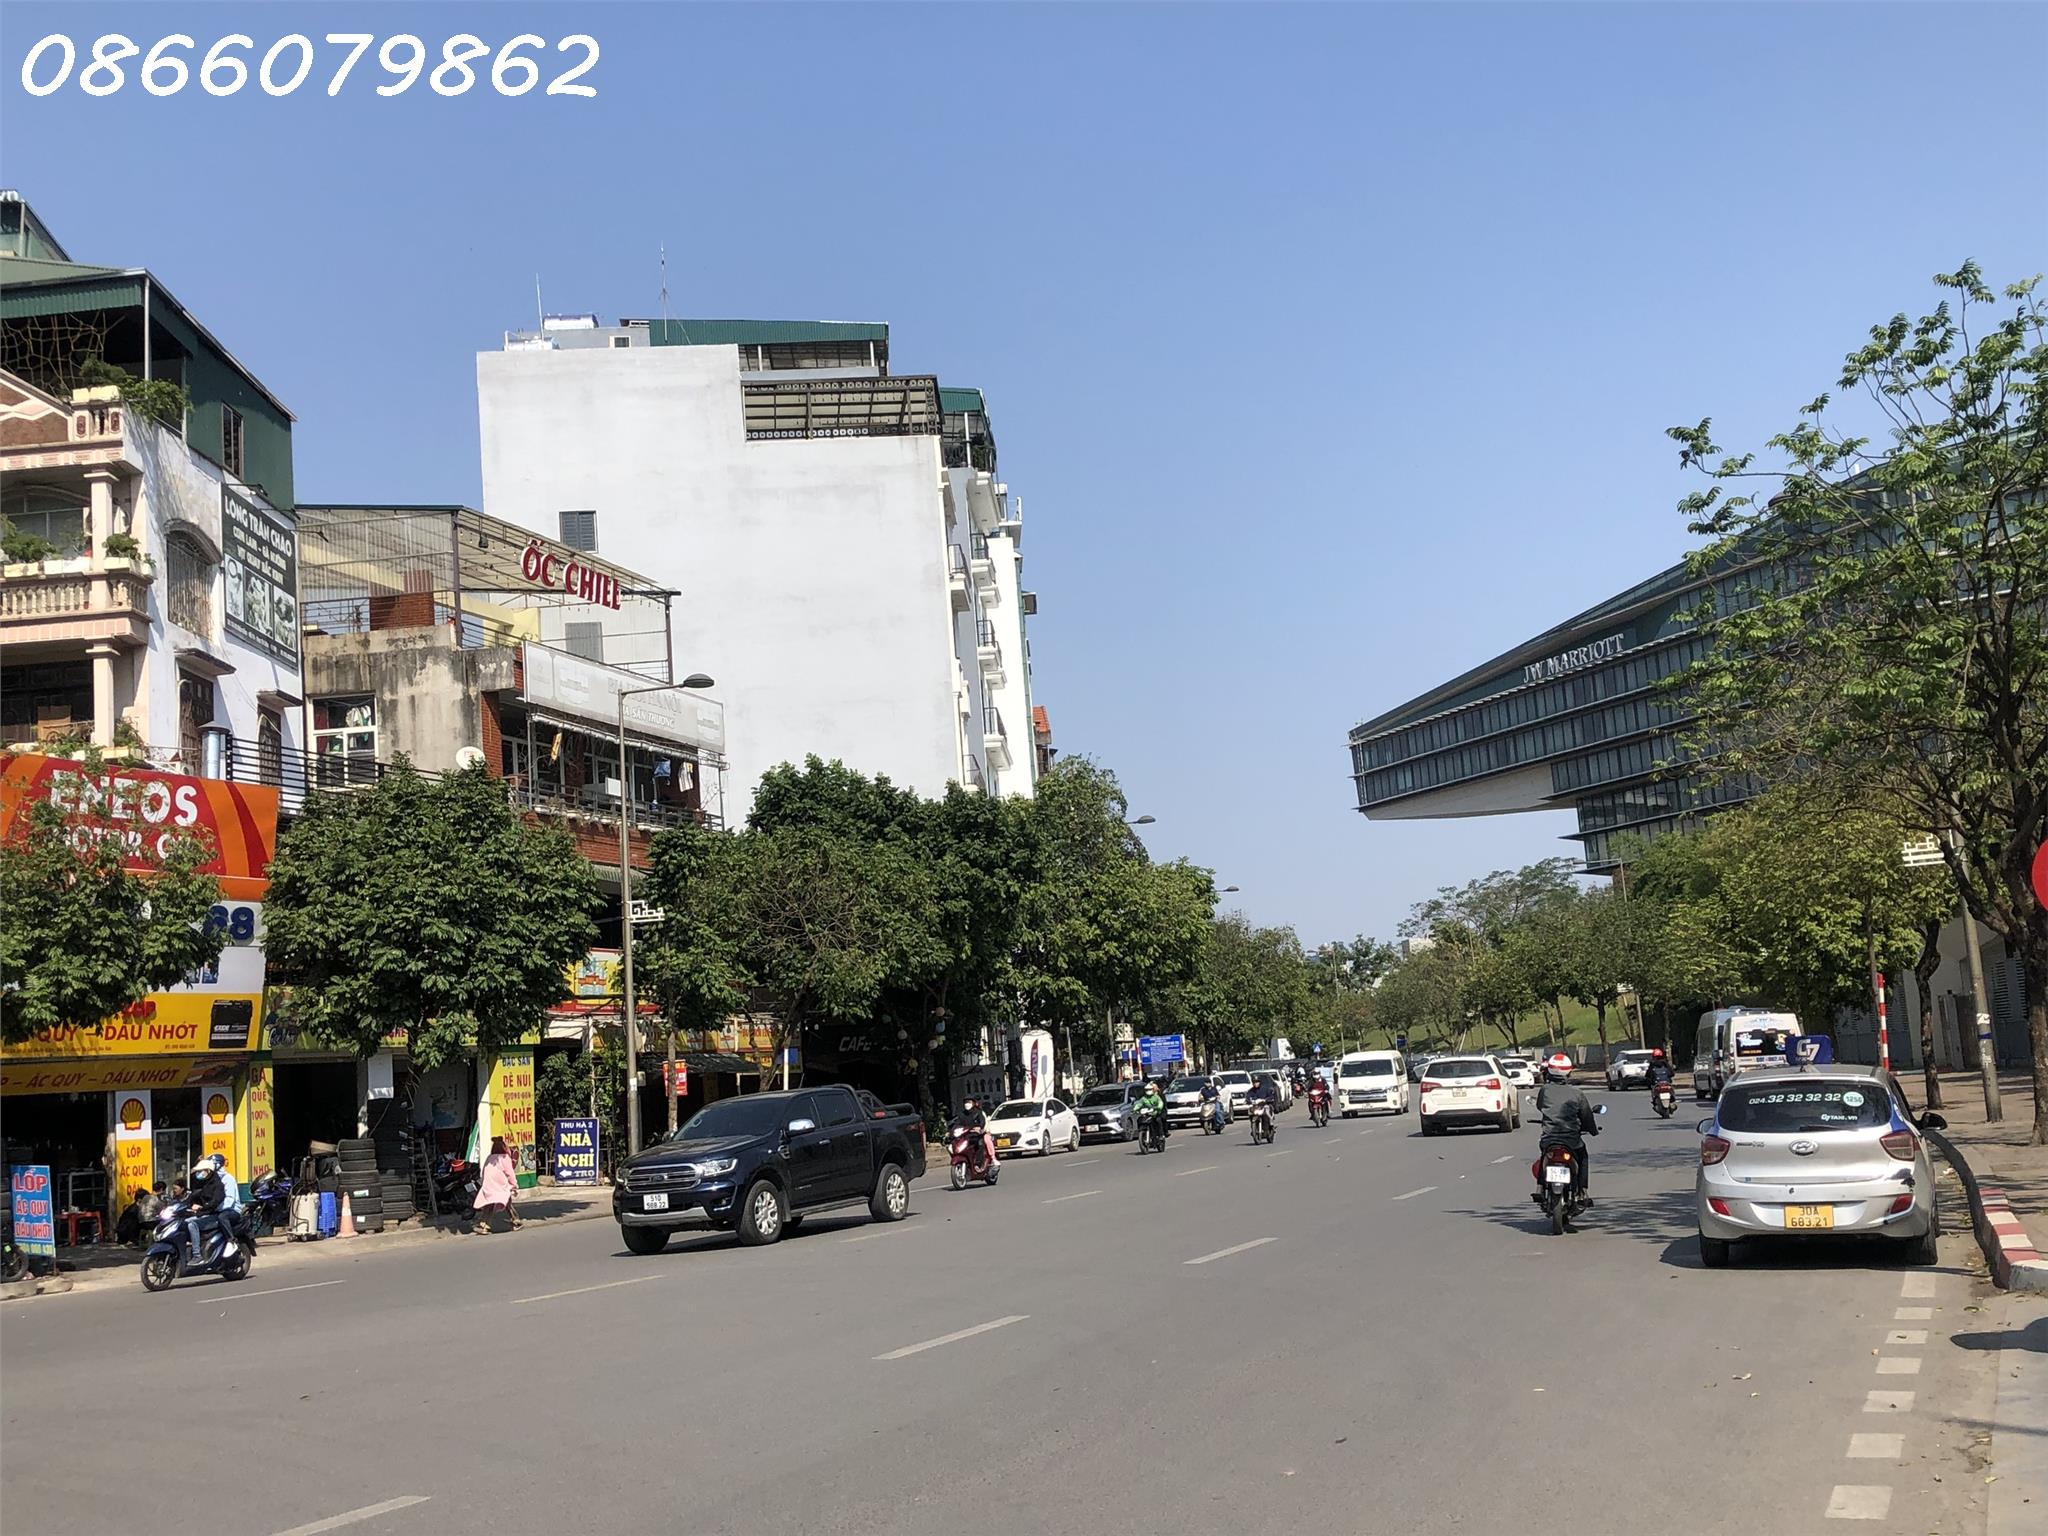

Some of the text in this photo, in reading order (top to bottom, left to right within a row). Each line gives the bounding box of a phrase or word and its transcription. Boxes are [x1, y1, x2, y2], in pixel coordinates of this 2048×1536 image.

[1523, 633, 1625, 684] JW MARRIOTT
[51, 769, 198, 827] ENEOS
[560, 1129, 592, 1147] NHÀ
[557, 1148, 595, 1168] NGHỈ
[132, 1165, 149, 1177] QUY
[1799, 1206, 1819, 1216] 30A
